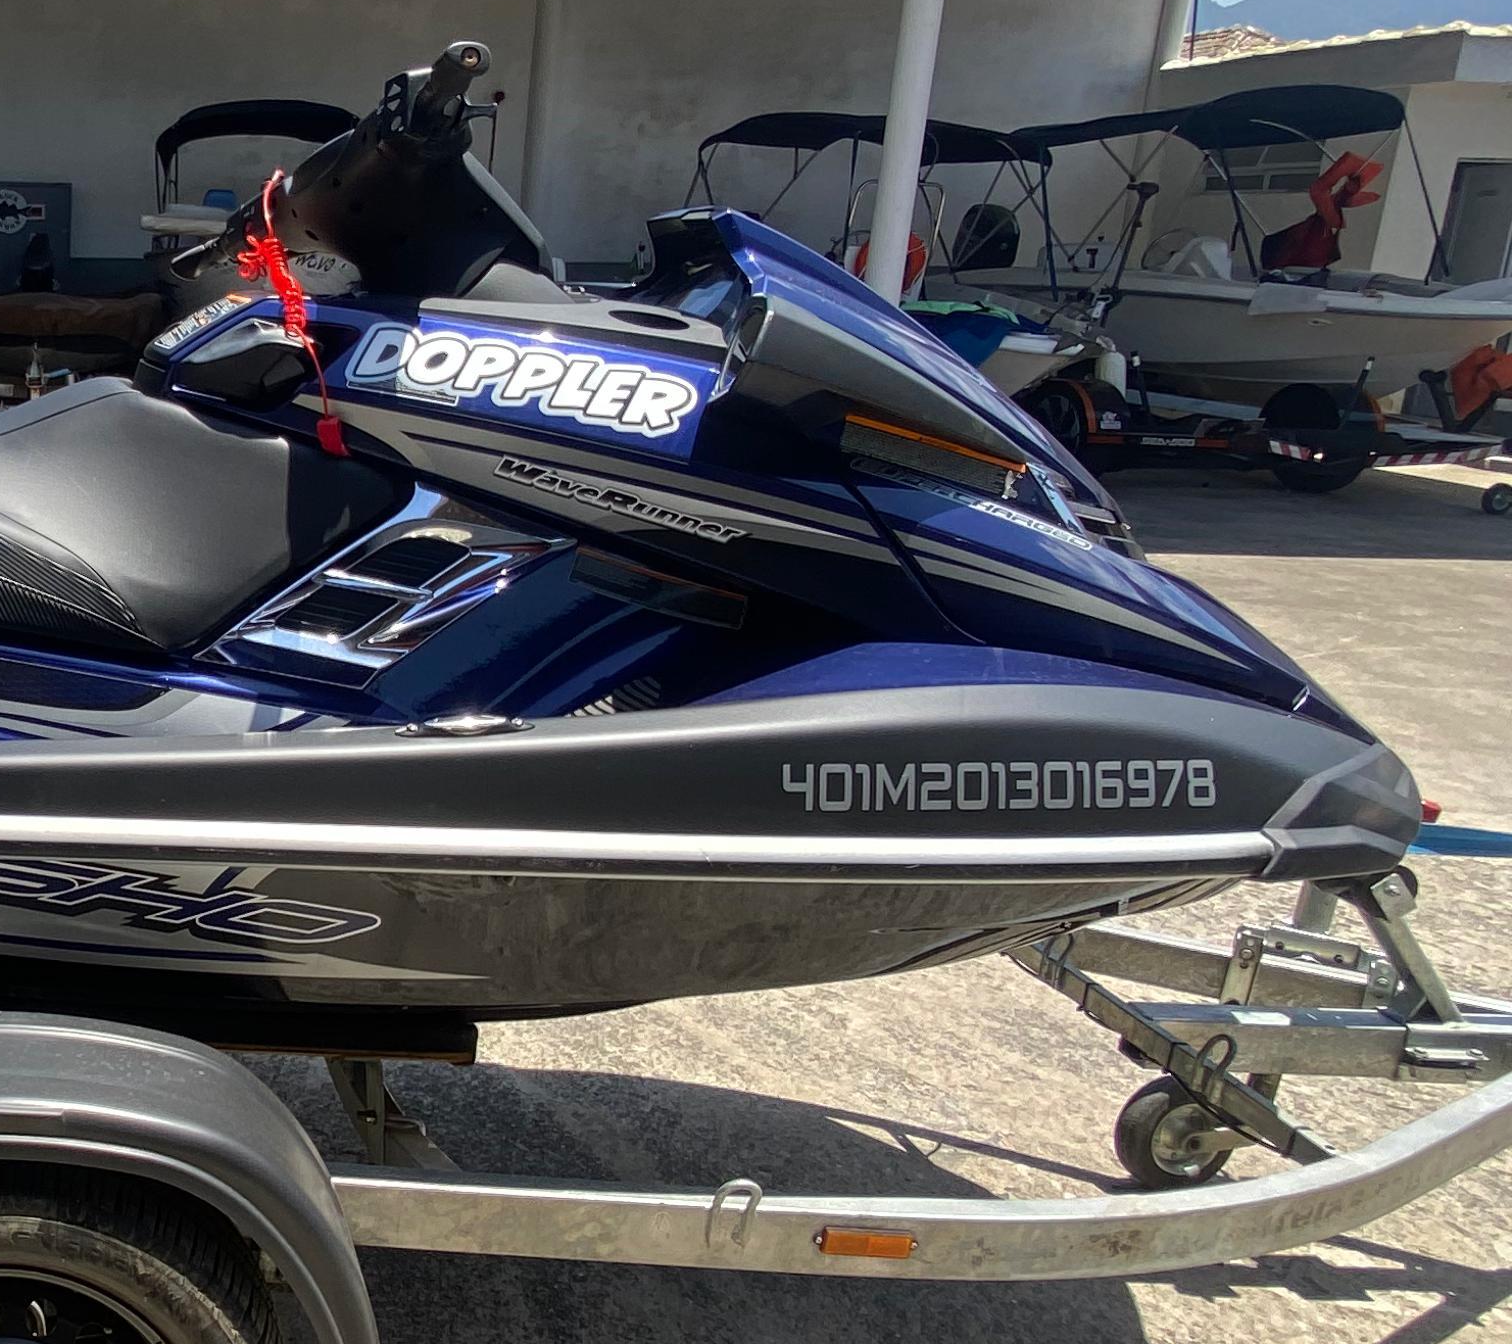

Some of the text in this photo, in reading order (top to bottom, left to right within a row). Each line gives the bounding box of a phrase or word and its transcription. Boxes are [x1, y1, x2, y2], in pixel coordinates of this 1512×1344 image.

[347, 323, 696, 436] DOPPLER
[493, 455, 749, 544] WaveRunner
[781, 759, 1216, 812] 401M2013016978
